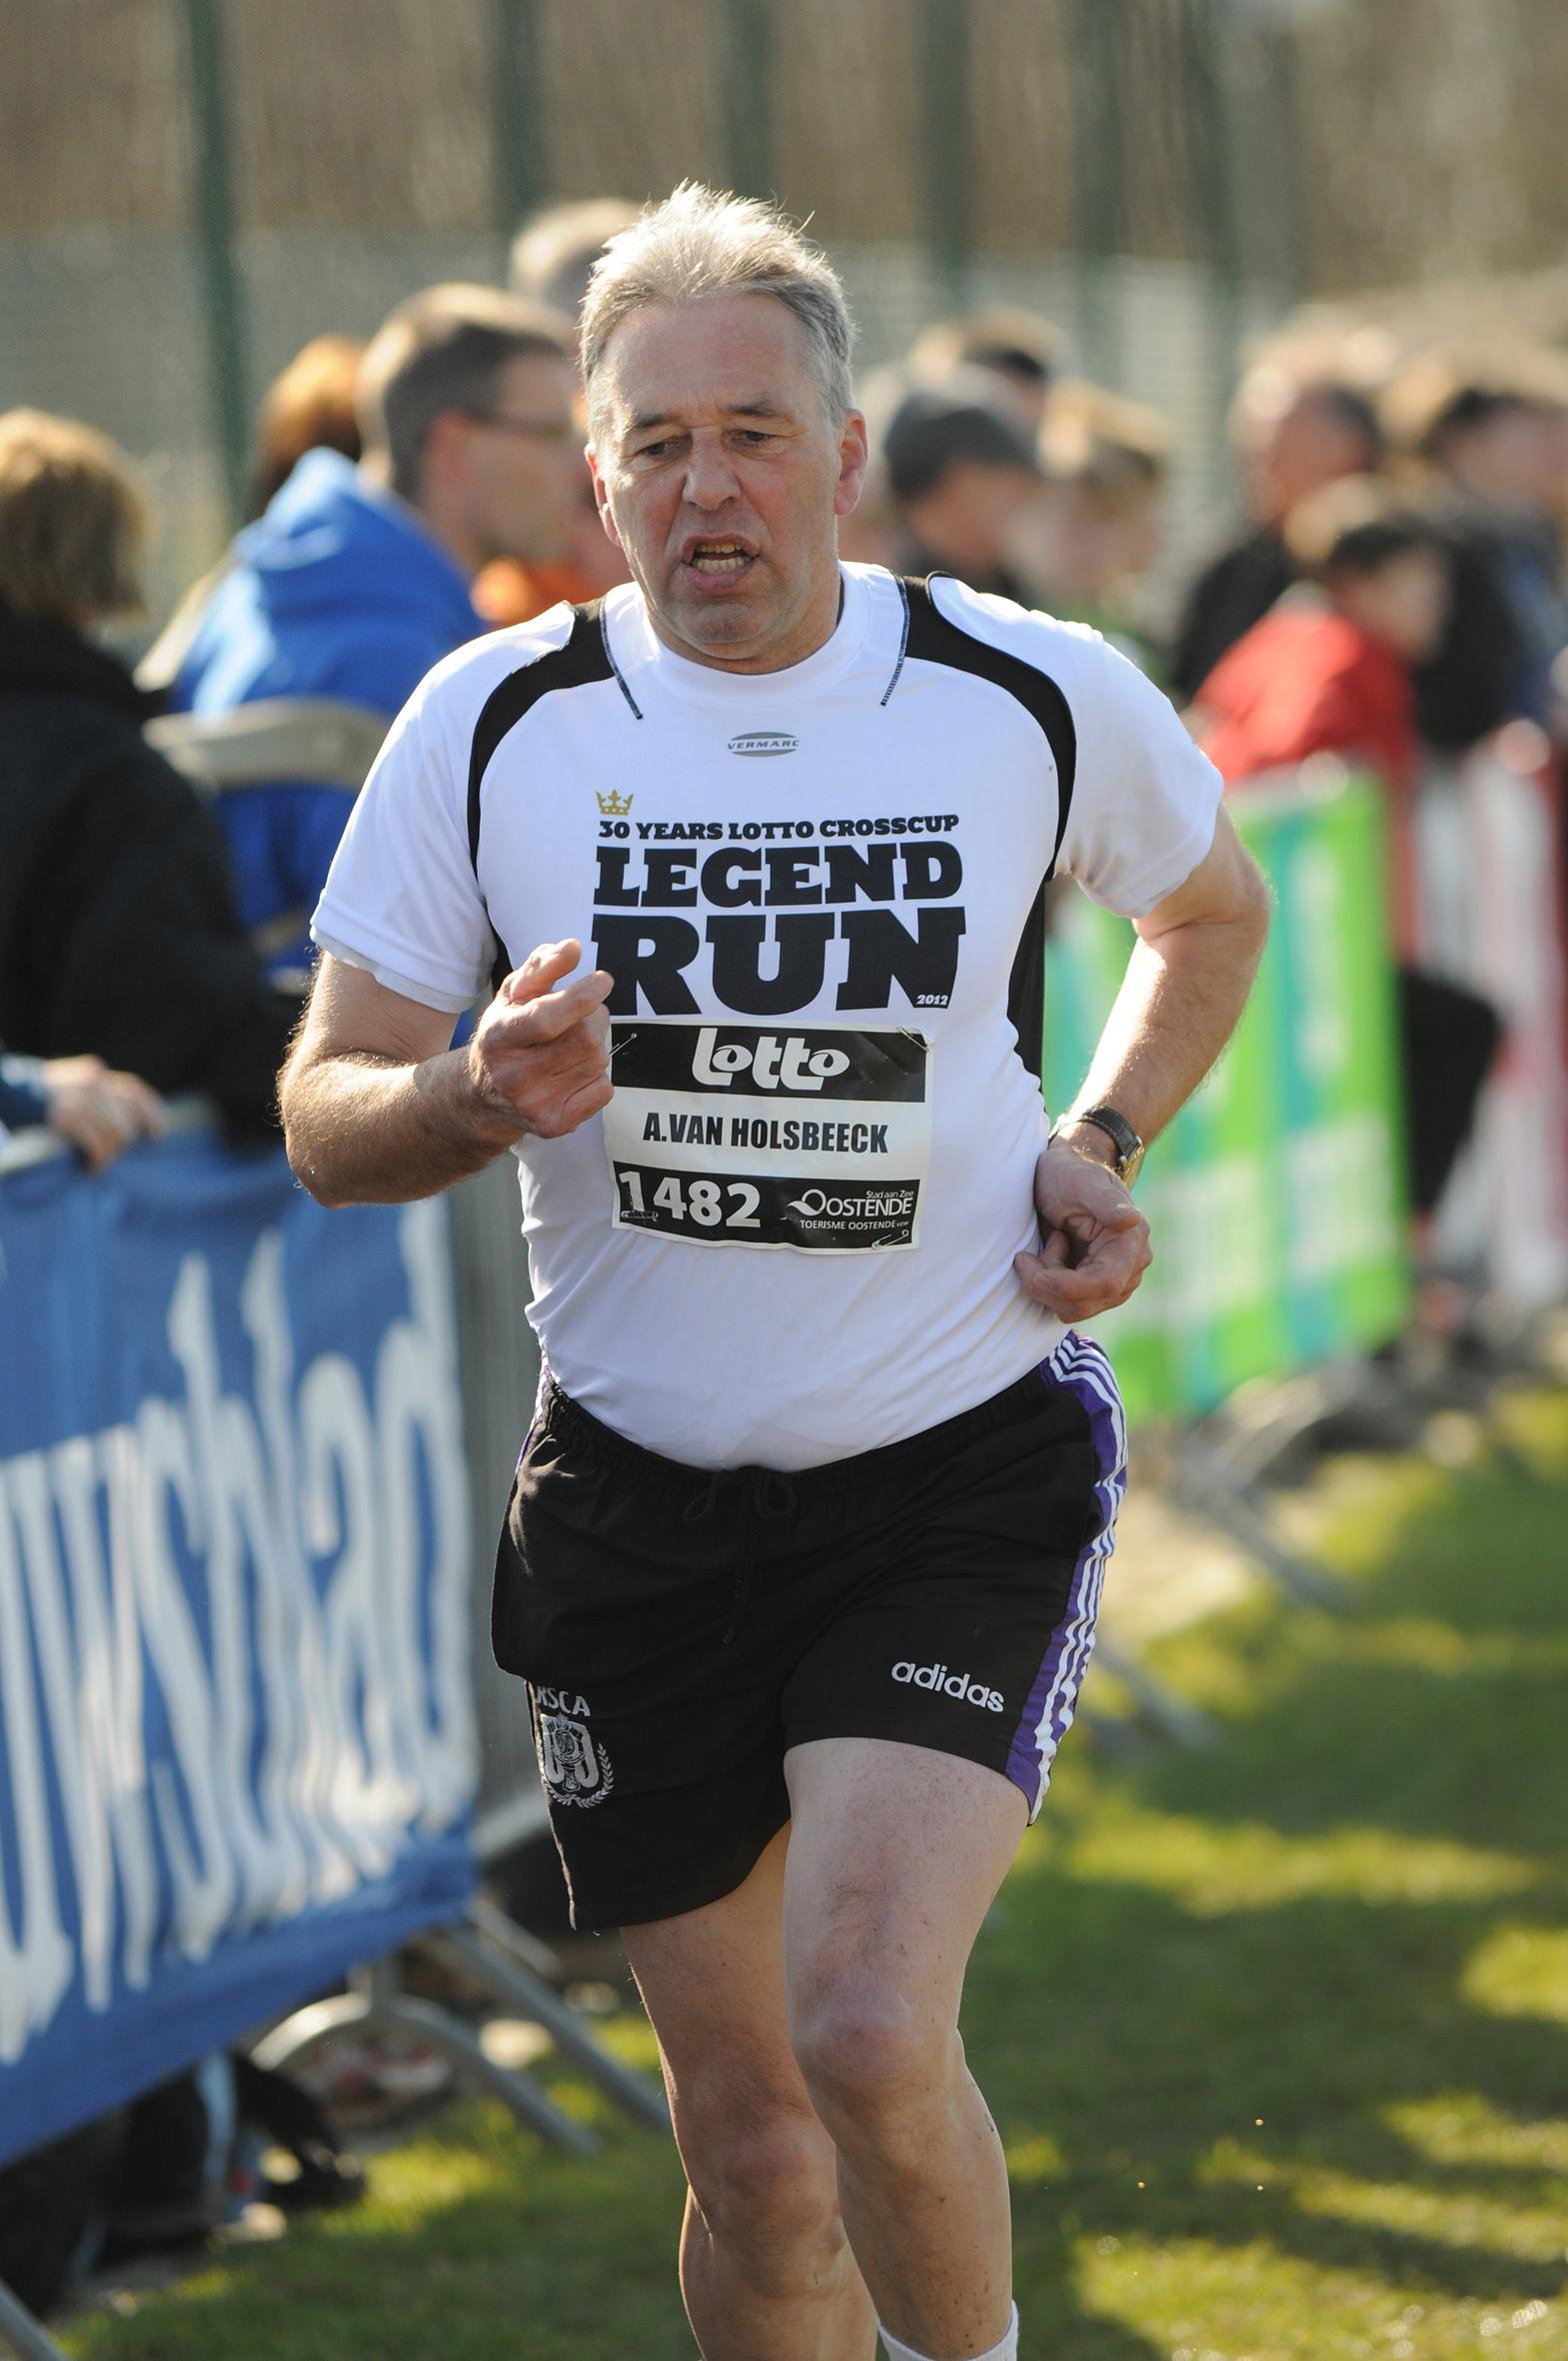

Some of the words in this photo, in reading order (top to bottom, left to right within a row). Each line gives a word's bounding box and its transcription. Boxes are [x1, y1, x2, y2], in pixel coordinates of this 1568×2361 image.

[728, 740, 799, 751] VERMARC
[599, 821, 630, 839] 30
[636, 821, 724, 840] YEARS
[729, 821, 814, 840] LOTTO
[819, 815, 959, 838] CROSSCUP
[594, 841, 963, 908] LEGEND
[591, 906, 966, 1016] RUN
[916, 994, 948, 1006] 2012
[643, 1113, 725, 1146] A.VAN
[731, 1118, 889, 1154] HOLSBEECK
[619, 1171, 762, 1228] 1482
[865, 1189, 884, 1199] Stad
[899, 1189, 914, 1198] Zee
[799, 1219, 846, 1230] TOERISME
[847, 1219, 896, 1229] OOSTENDE
[890, 1661, 1005, 1713] adidas
